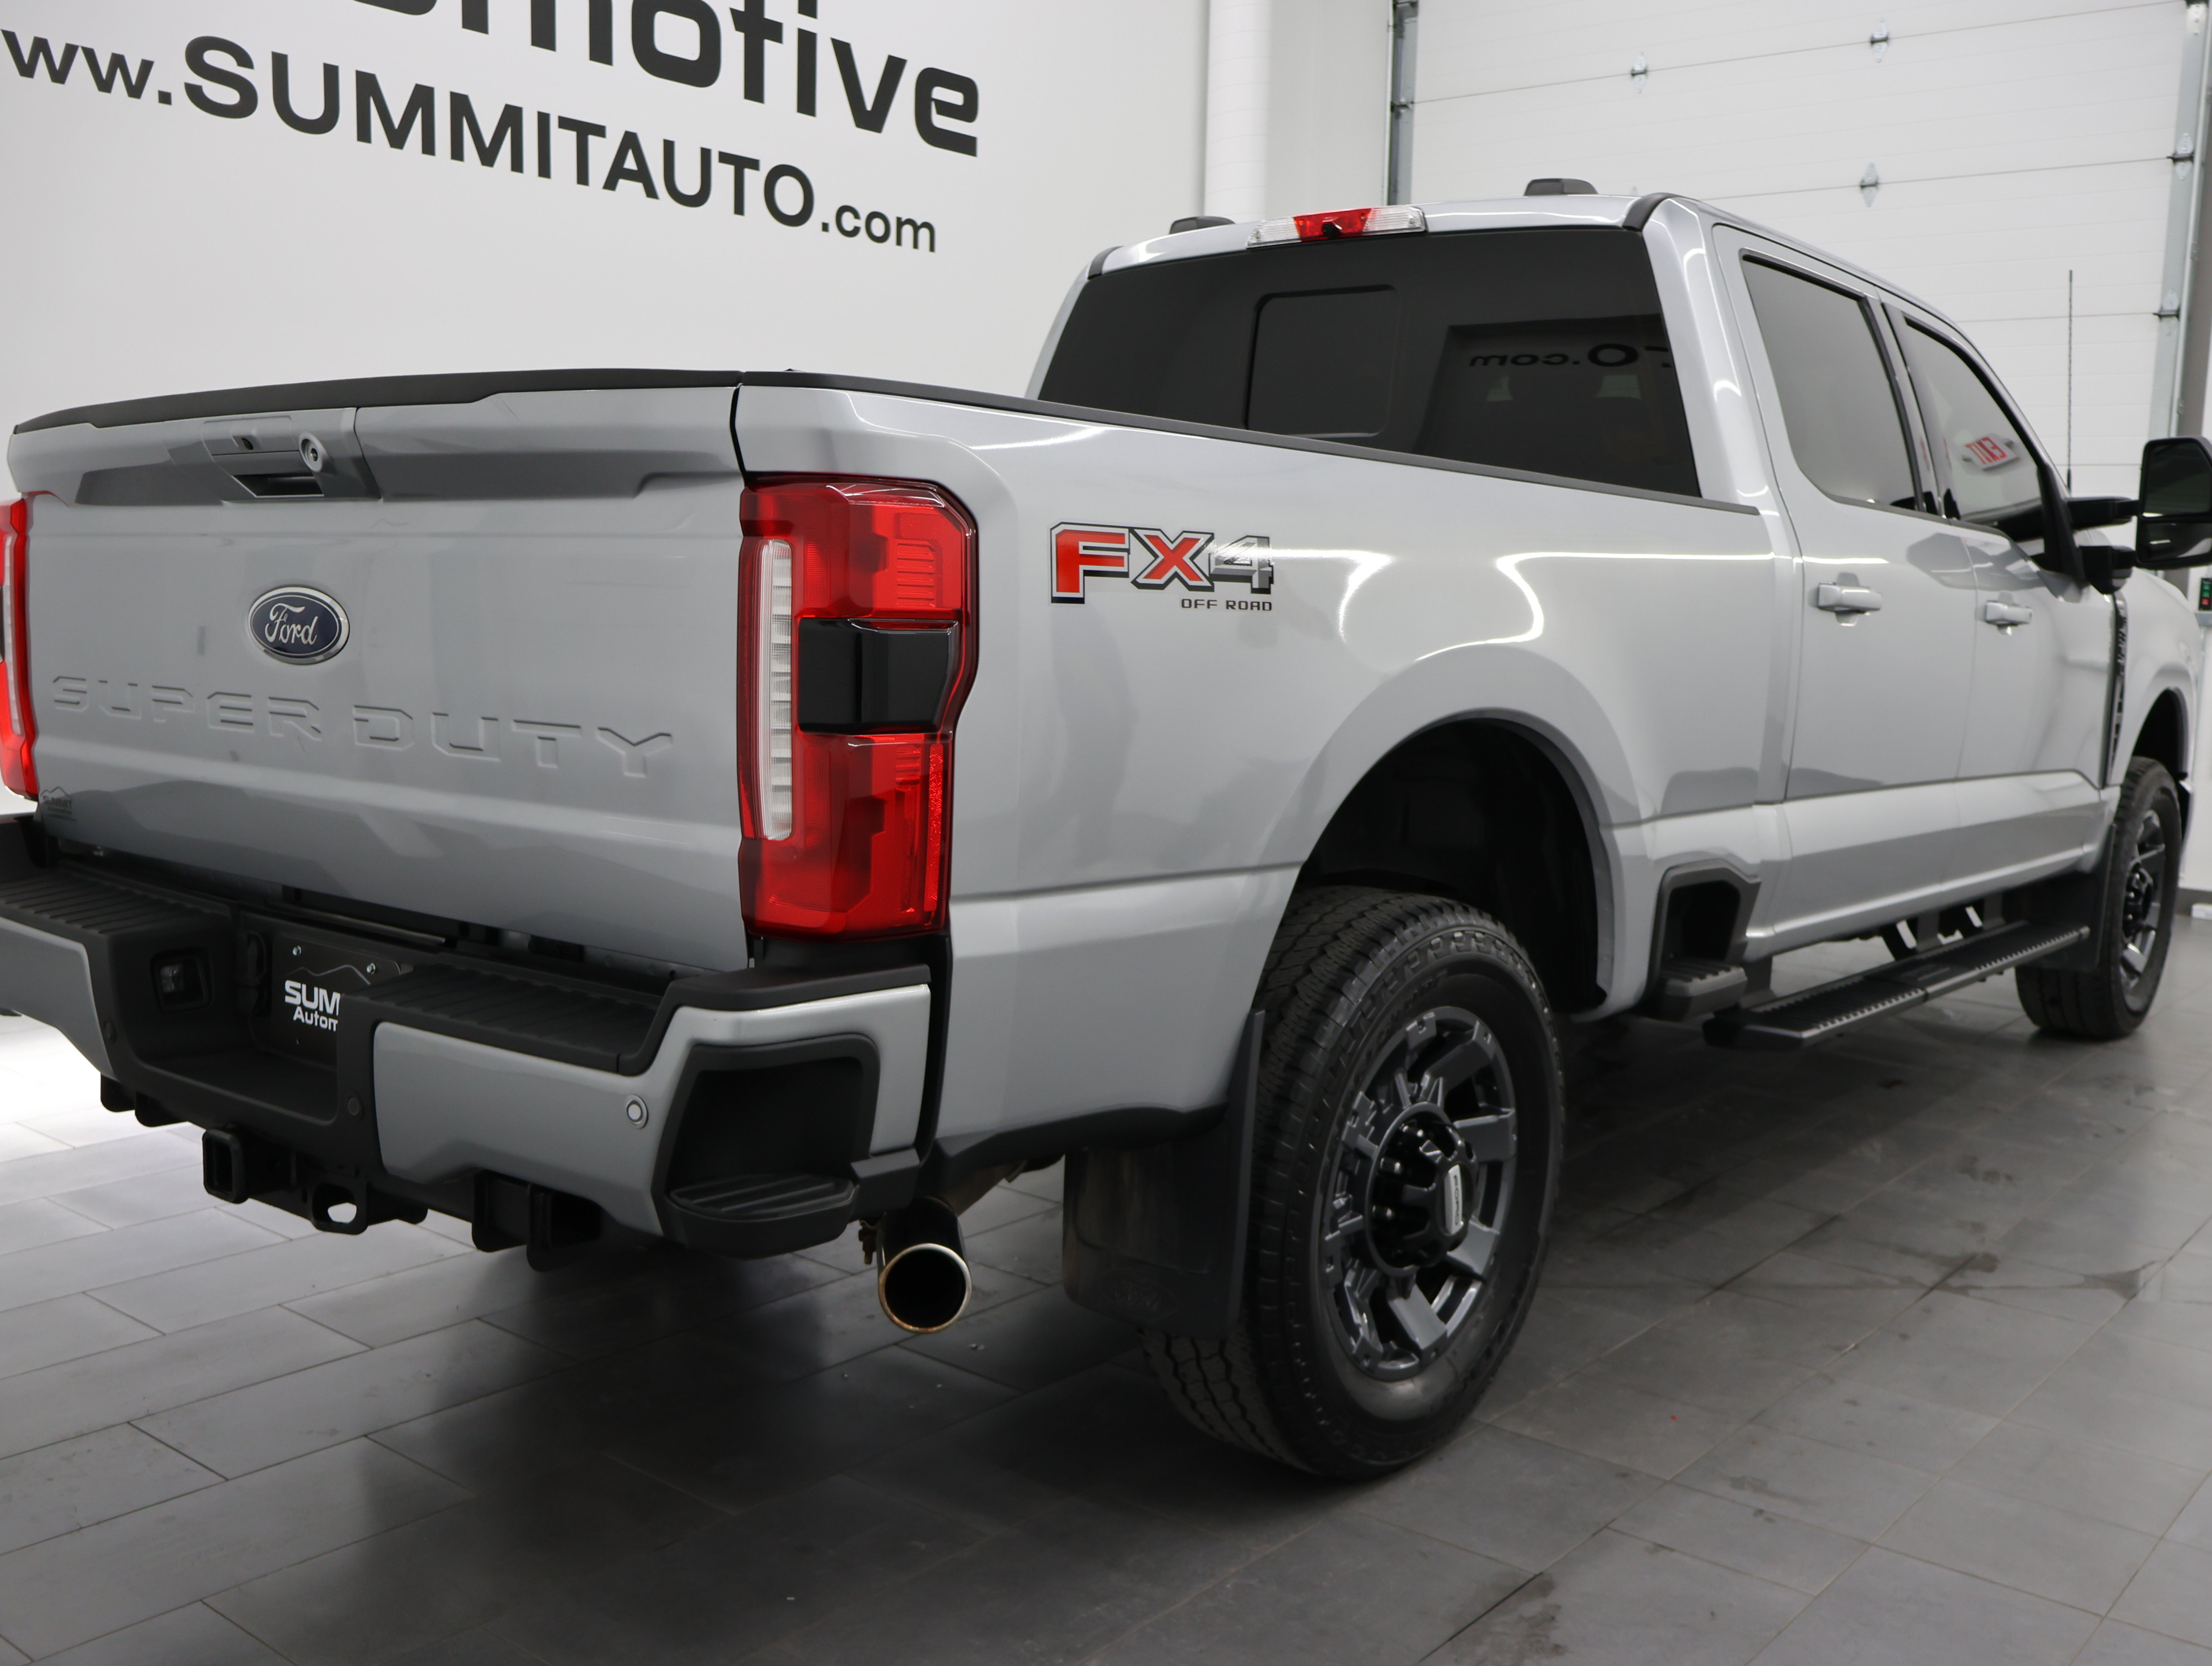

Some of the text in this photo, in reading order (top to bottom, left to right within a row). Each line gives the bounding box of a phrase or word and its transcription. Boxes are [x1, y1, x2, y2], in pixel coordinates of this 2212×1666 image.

[1050, 521, 1274, 604] FX4
[265, 602, 319, 645] Ford
[1181, 599, 1272, 611] OFF ROAD
[53, 676, 673, 778] SUPER DUTY
